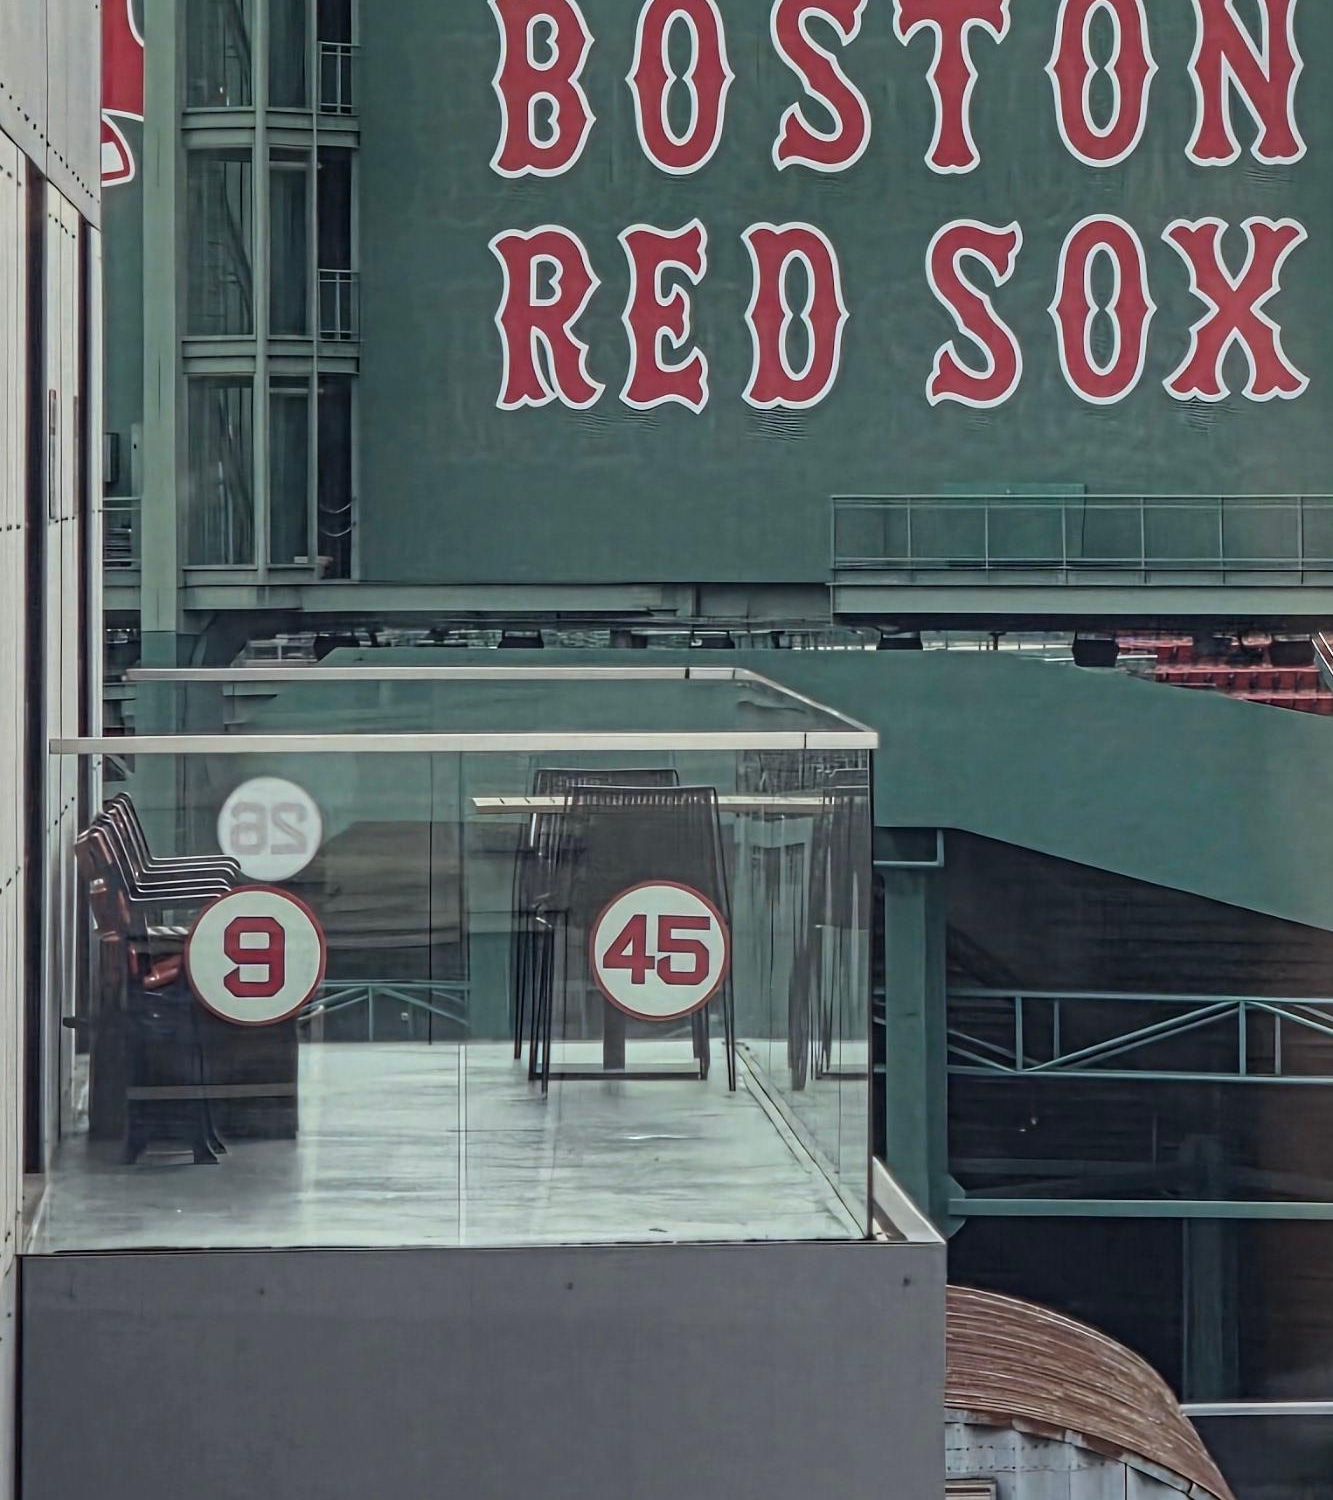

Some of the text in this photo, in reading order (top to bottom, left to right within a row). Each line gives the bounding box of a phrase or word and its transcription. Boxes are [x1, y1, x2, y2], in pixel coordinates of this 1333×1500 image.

[487, 213, 1311, 414] RED SOX
[223, 916, 286, 998] 9
[601, 914, 712, 986] 45
